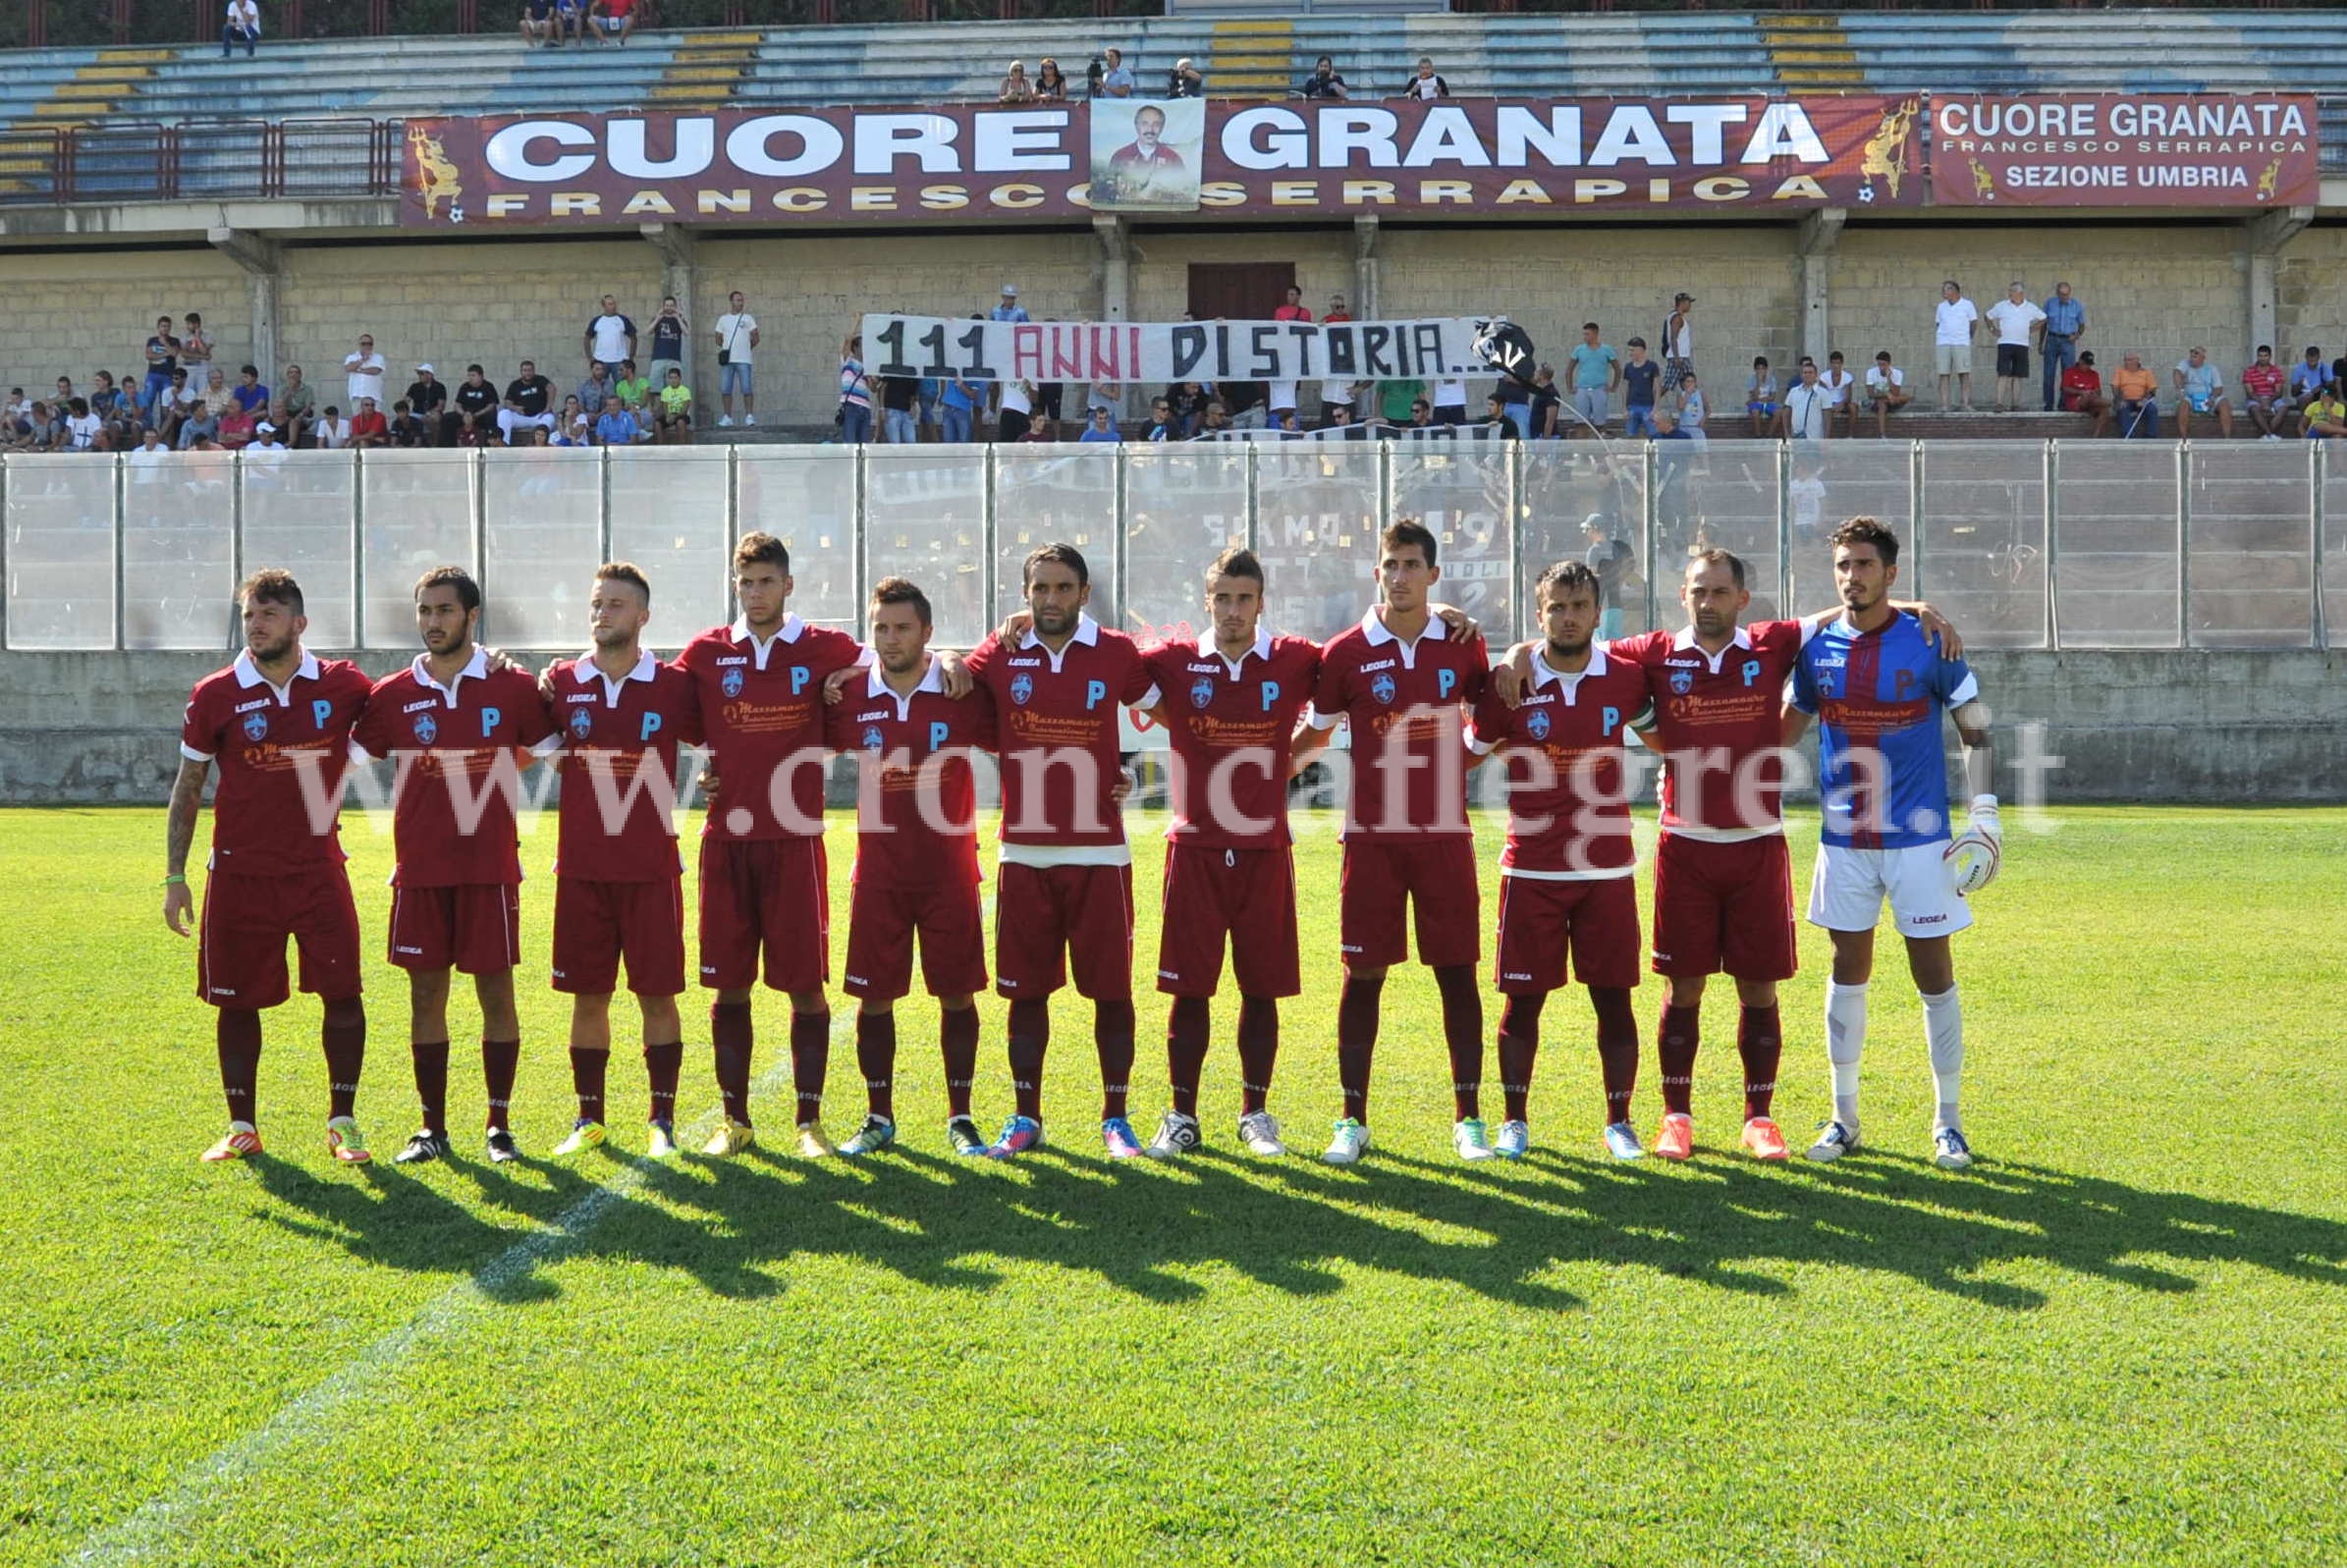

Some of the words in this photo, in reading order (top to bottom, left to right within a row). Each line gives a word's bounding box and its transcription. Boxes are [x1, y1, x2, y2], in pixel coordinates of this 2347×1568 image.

[1938, 102, 2096, 136] CUORE
[2108, 103, 2308, 136] GRANATA
[484, 109, 1071, 184] CUORE
[1220, 101, 1832, 172] GRANATA
[1941, 140, 2121, 153] FRANCESCO
[2137, 140, 2307, 153] SERRAPICA
[1200, 175, 1829, 206] SERRAPICA
[2005, 165, 2129, 188] SEZIONE
[2137, 165, 2249, 188] UMBRIA
[876, 321, 997, 378] 111
[1012, 325, 1142, 380] ANNI
[716, 656, 748, 667] LEGEA
[1007, 657, 1042, 668] LEGEA
[1186, 662, 1221, 676] LEGEA
[1360, 658, 1395, 674] LEGEA
[1664, 657, 1701, 669] LEGEA
[1741, 660, 1761, 686] P
[790, 666, 810, 695] P
[1086, 679, 1107, 711] P
[1438, 668, 1456, 699] P
[1895, 670, 1914, 701] P
[235, 697, 272, 714] LEGEA
[566, 693, 598, 704] LEGEA
[1261, 680, 1281, 712] P
[312, 699, 332, 730] P
[480, 707, 501, 737] P
[640, 711, 662, 741] P
[856, 710, 889, 723] LEGEA
[1602, 706, 1620, 736] P
[929, 721, 950, 752] P
[1912, 913, 1947, 924] LEGEA
